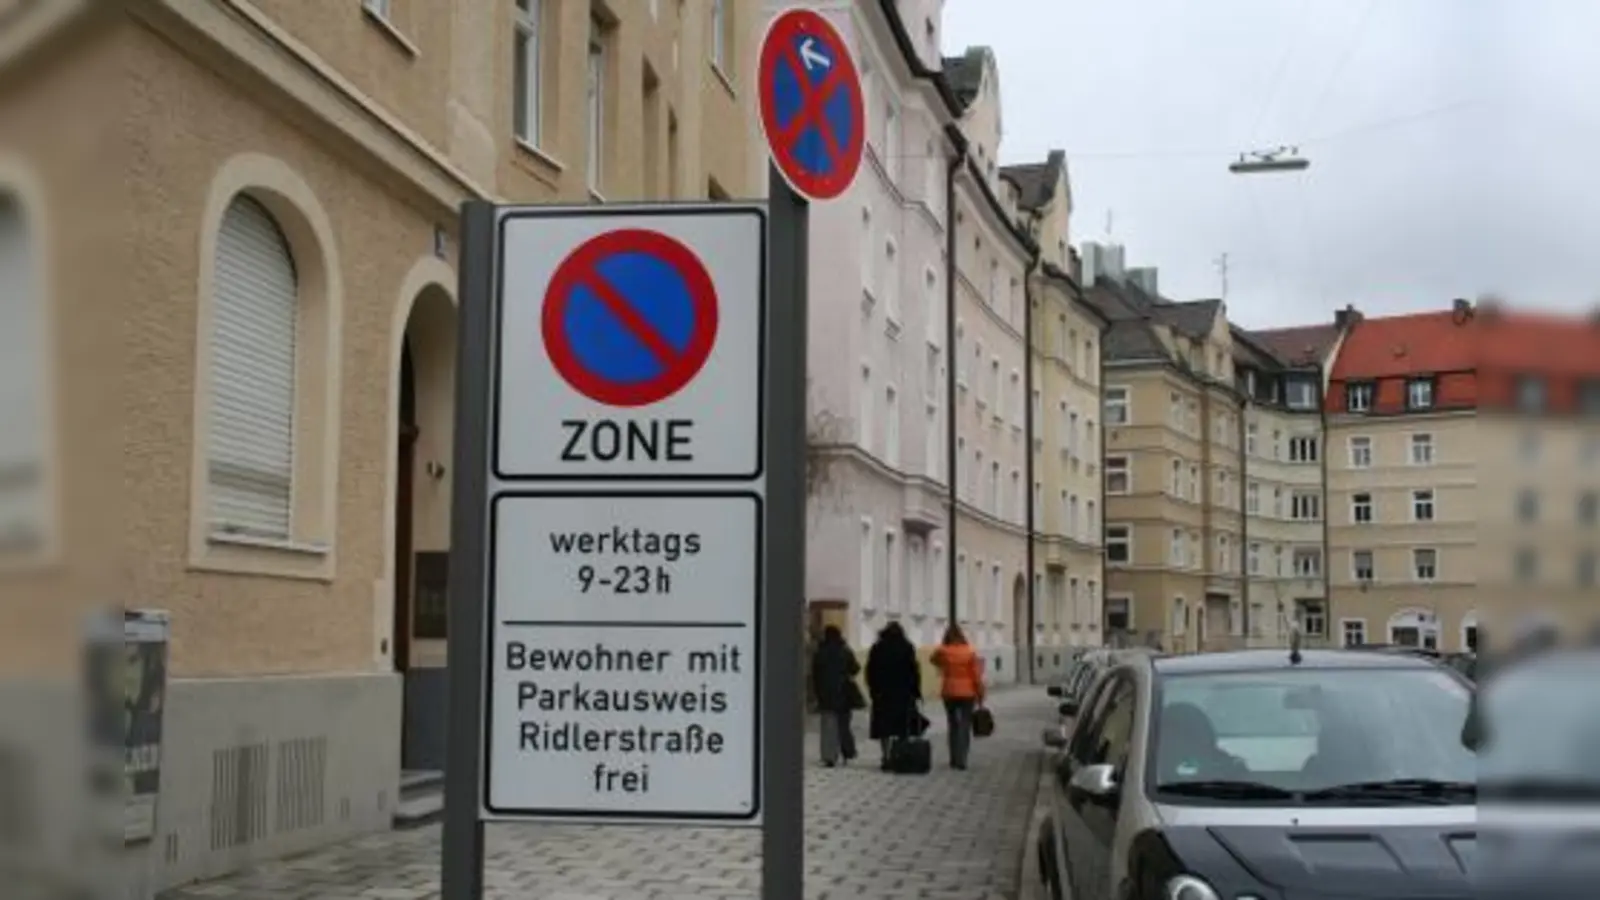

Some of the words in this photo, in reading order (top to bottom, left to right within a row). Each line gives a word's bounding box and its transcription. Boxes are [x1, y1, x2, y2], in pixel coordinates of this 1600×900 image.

[561, 420, 693, 461] ZONE
[551, 527, 700, 561] werktags
[507, 642, 670, 671] Bewohner
[689, 645, 739, 671] mit
[519, 682, 726, 712] Parkausweis
[520, 722, 723, 753] Ridlerstraße
[595, 764, 647, 792] frei
